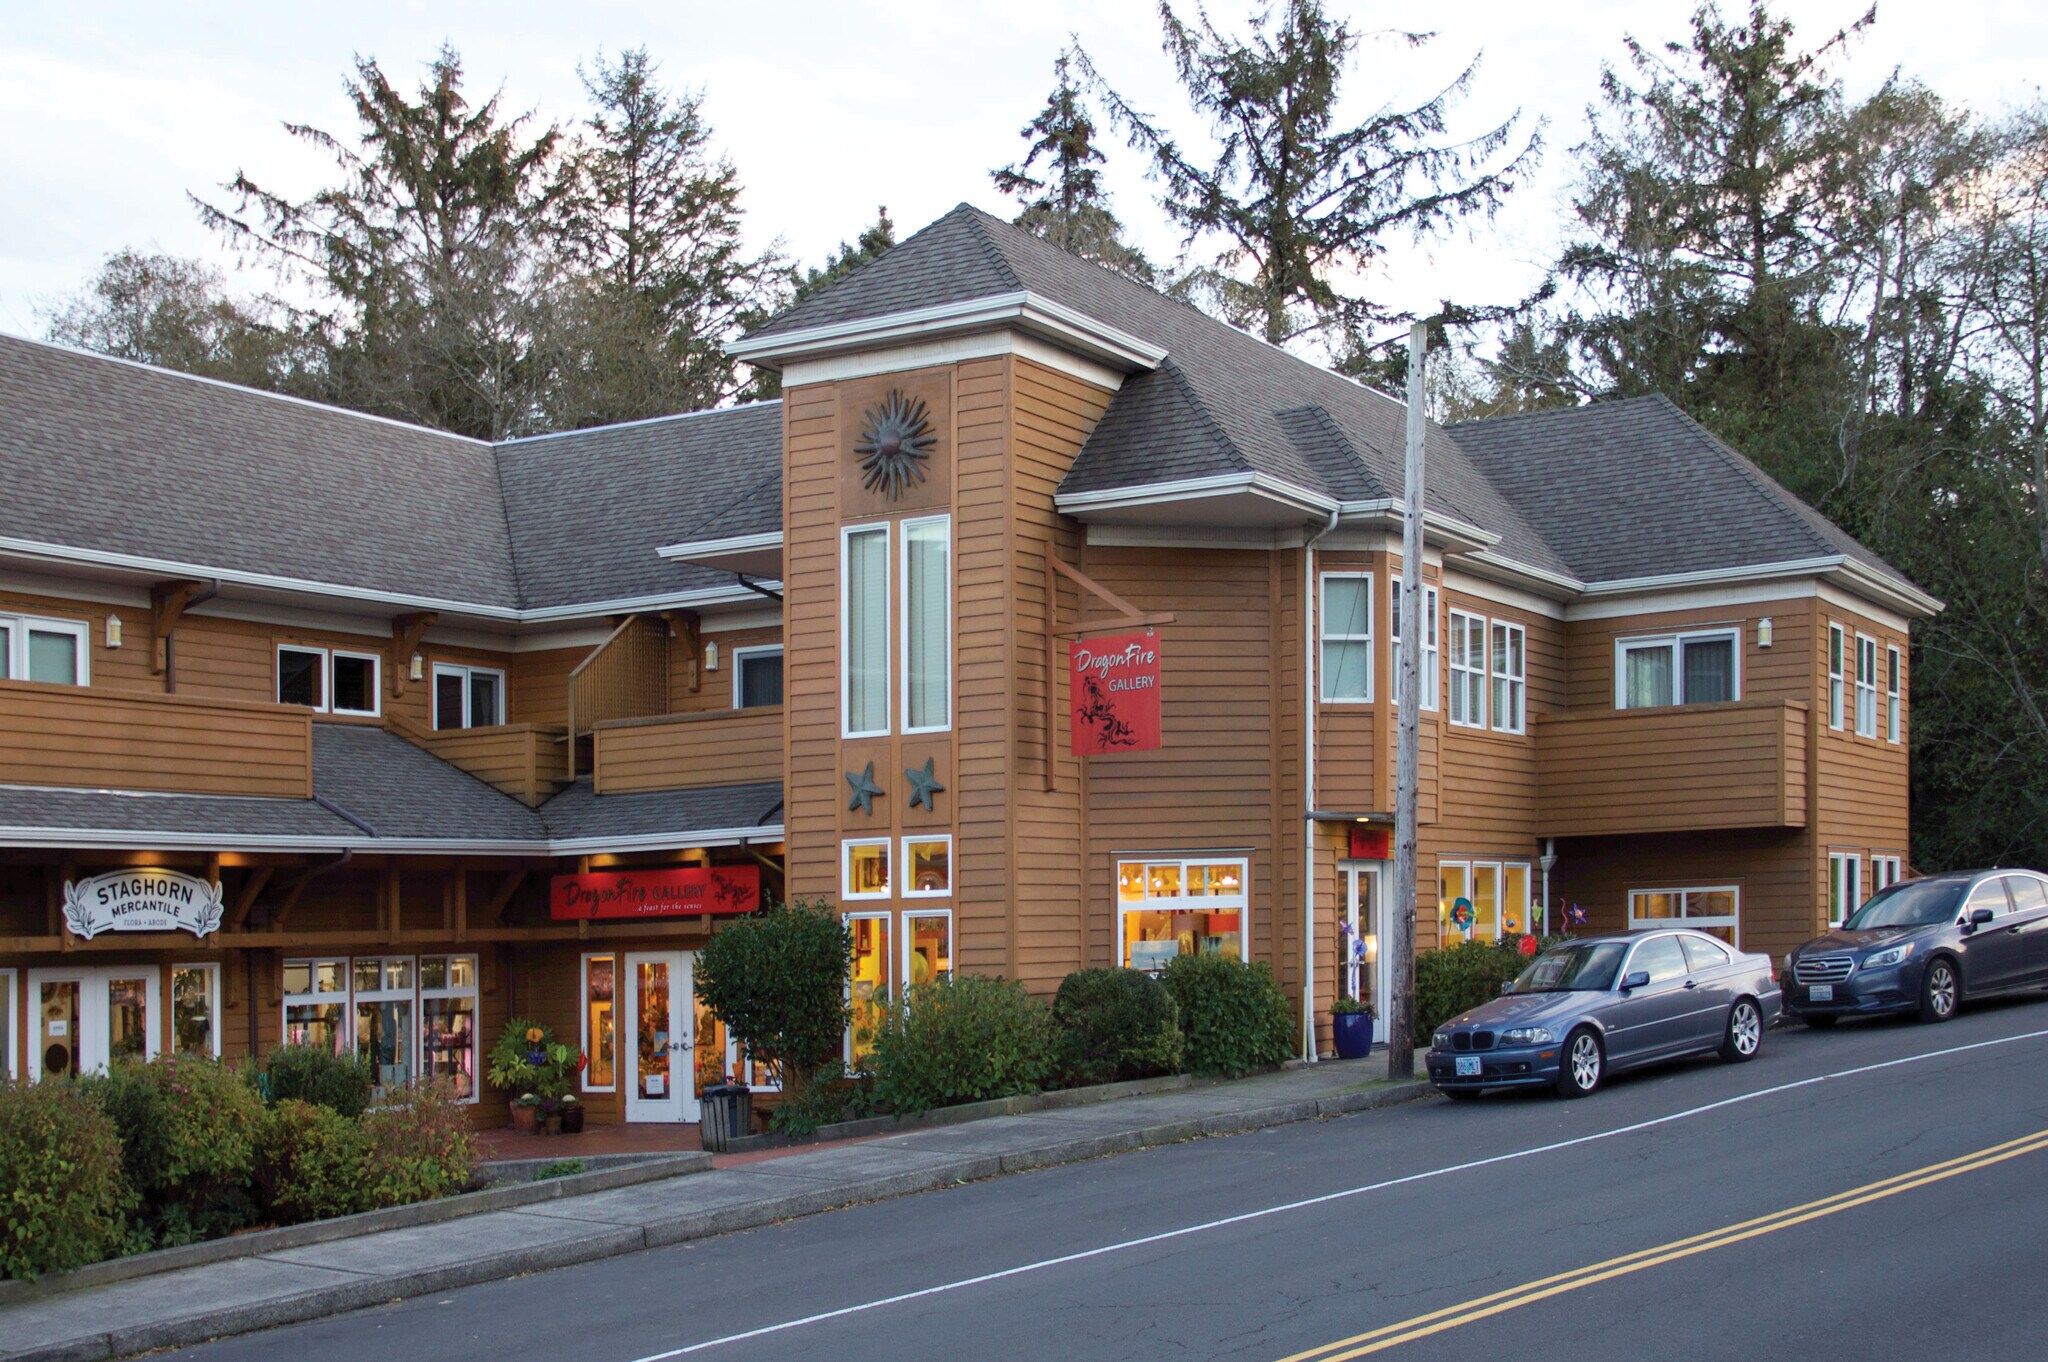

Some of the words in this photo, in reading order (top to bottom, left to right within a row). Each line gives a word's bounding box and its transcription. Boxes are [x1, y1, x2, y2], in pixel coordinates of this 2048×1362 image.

[1074, 643, 1156, 679] DragonFire
[1108, 675, 1155, 692] GALLERY
[97, 879, 194, 906] STAGHORN
[562, 877, 647, 915] DragonFire
[653, 884, 705, 900] GALLERY
[111, 900, 181, 918] MERCANTILE
[643, 903, 658, 913] feast
[660, 902, 670, 913] for
[671, 901, 682, 910] the
[124, 919, 142, 927] FLORA
